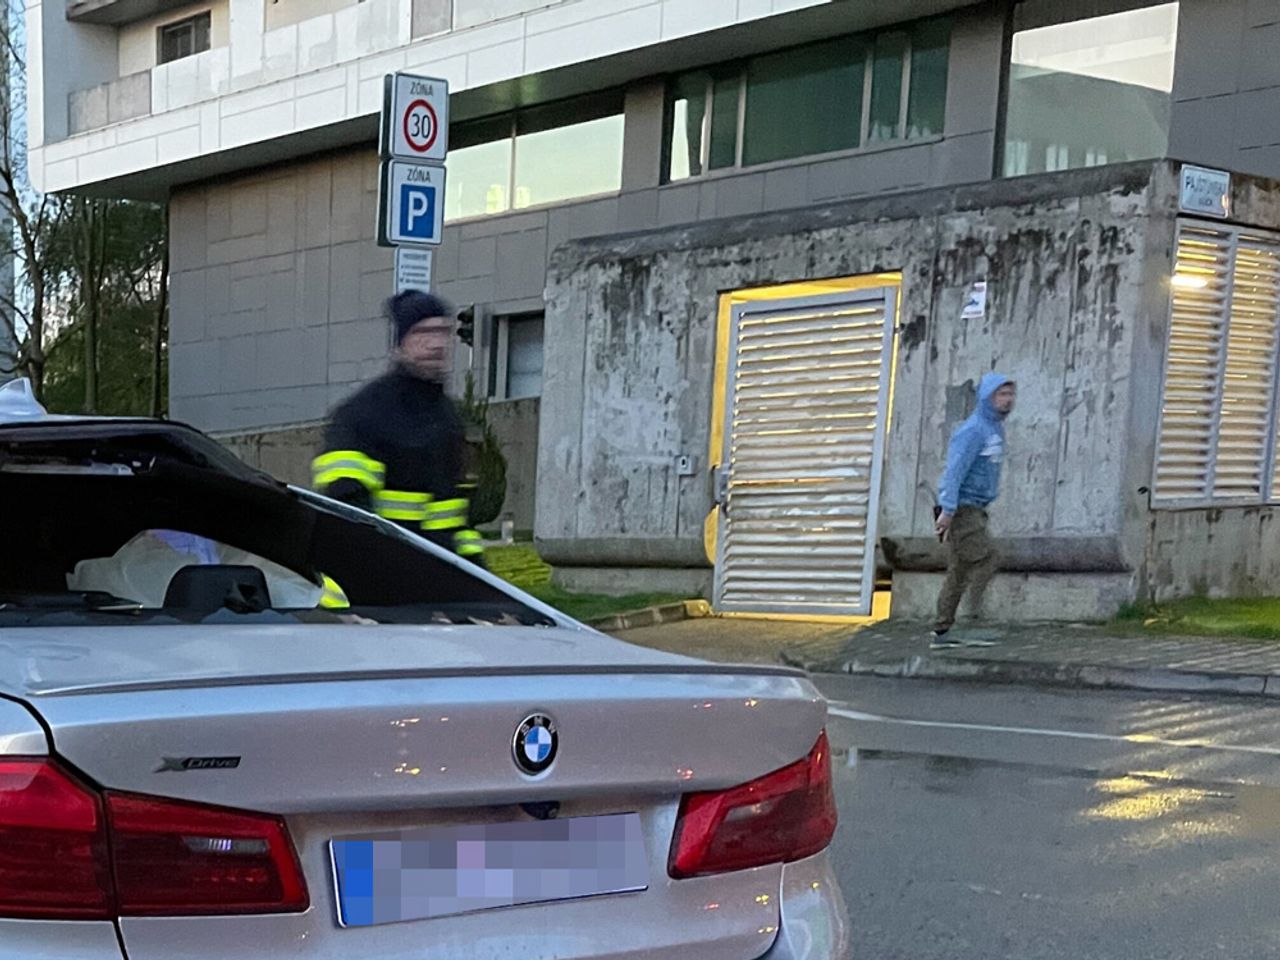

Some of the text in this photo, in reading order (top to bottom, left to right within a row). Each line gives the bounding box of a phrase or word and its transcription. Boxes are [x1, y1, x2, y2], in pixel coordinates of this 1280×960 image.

[409, 80, 434, 97] ZÓNA
[411, 113, 431, 139] 30
[406, 166, 432, 183] ZÓNA
[407, 190, 428, 231] P
[520, 716, 556, 737] BMW
